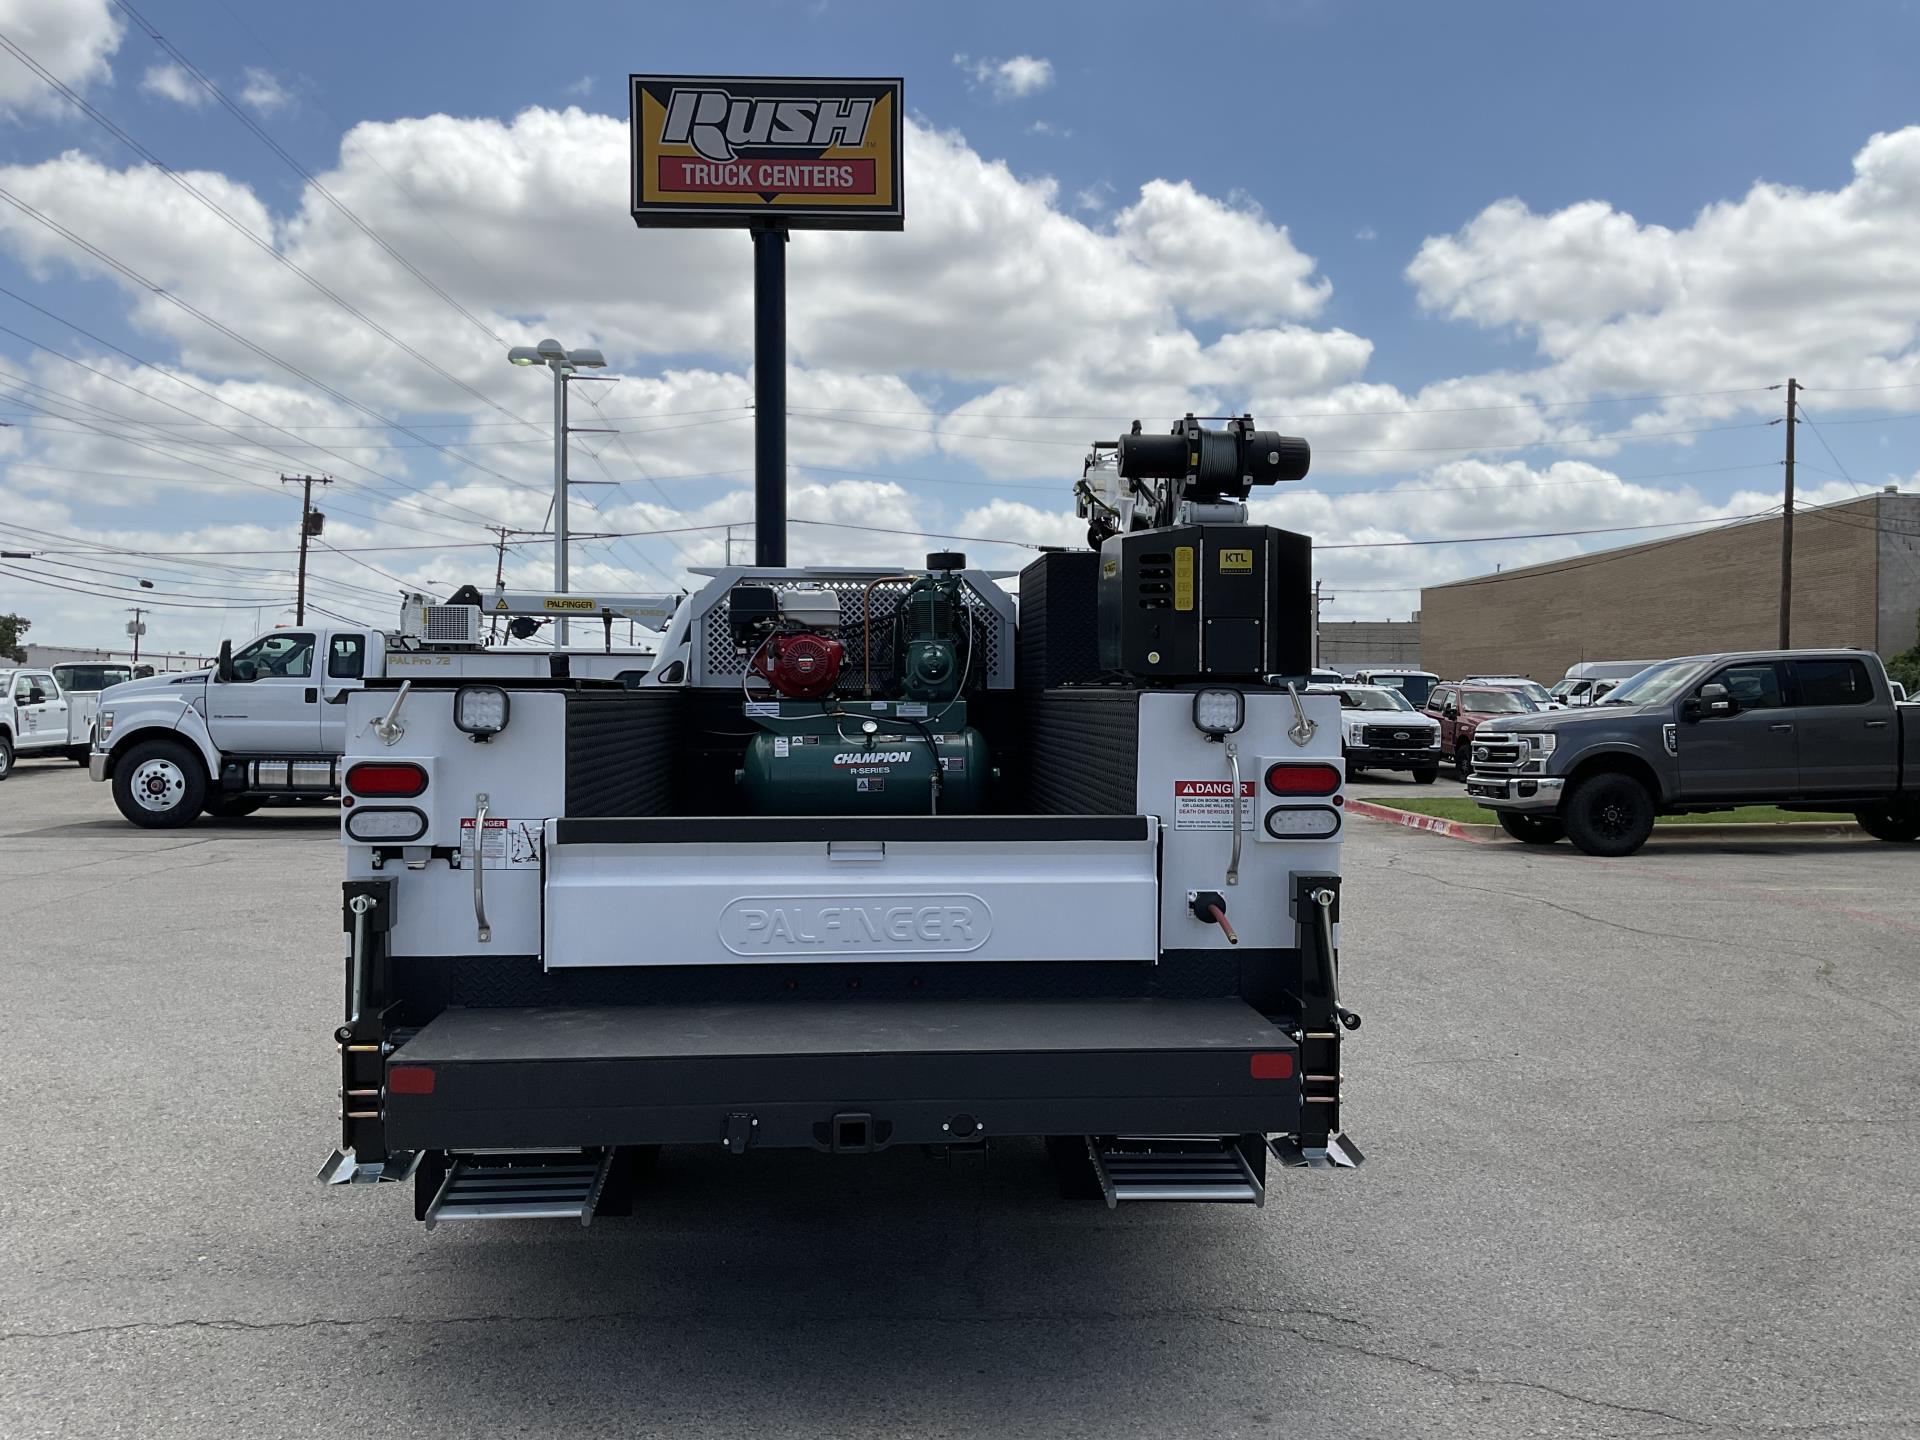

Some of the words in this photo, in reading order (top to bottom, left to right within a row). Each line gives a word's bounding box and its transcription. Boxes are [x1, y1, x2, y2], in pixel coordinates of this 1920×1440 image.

[682, 163, 753, 186] TRUCK
[758, 165, 853, 187] CENTERS
[1225, 553, 1248, 562] KTL
[546, 600, 592, 609] PALFINGER
[388, 656, 410, 665] PAL
[412, 656, 432, 665] Pro
[833, 751, 911, 765] CHAMPION
[850, 766, 890, 775] R-SERIES
[1196, 783, 1248, 794] DANGR
[739, 905, 974, 945] PALFINGER
